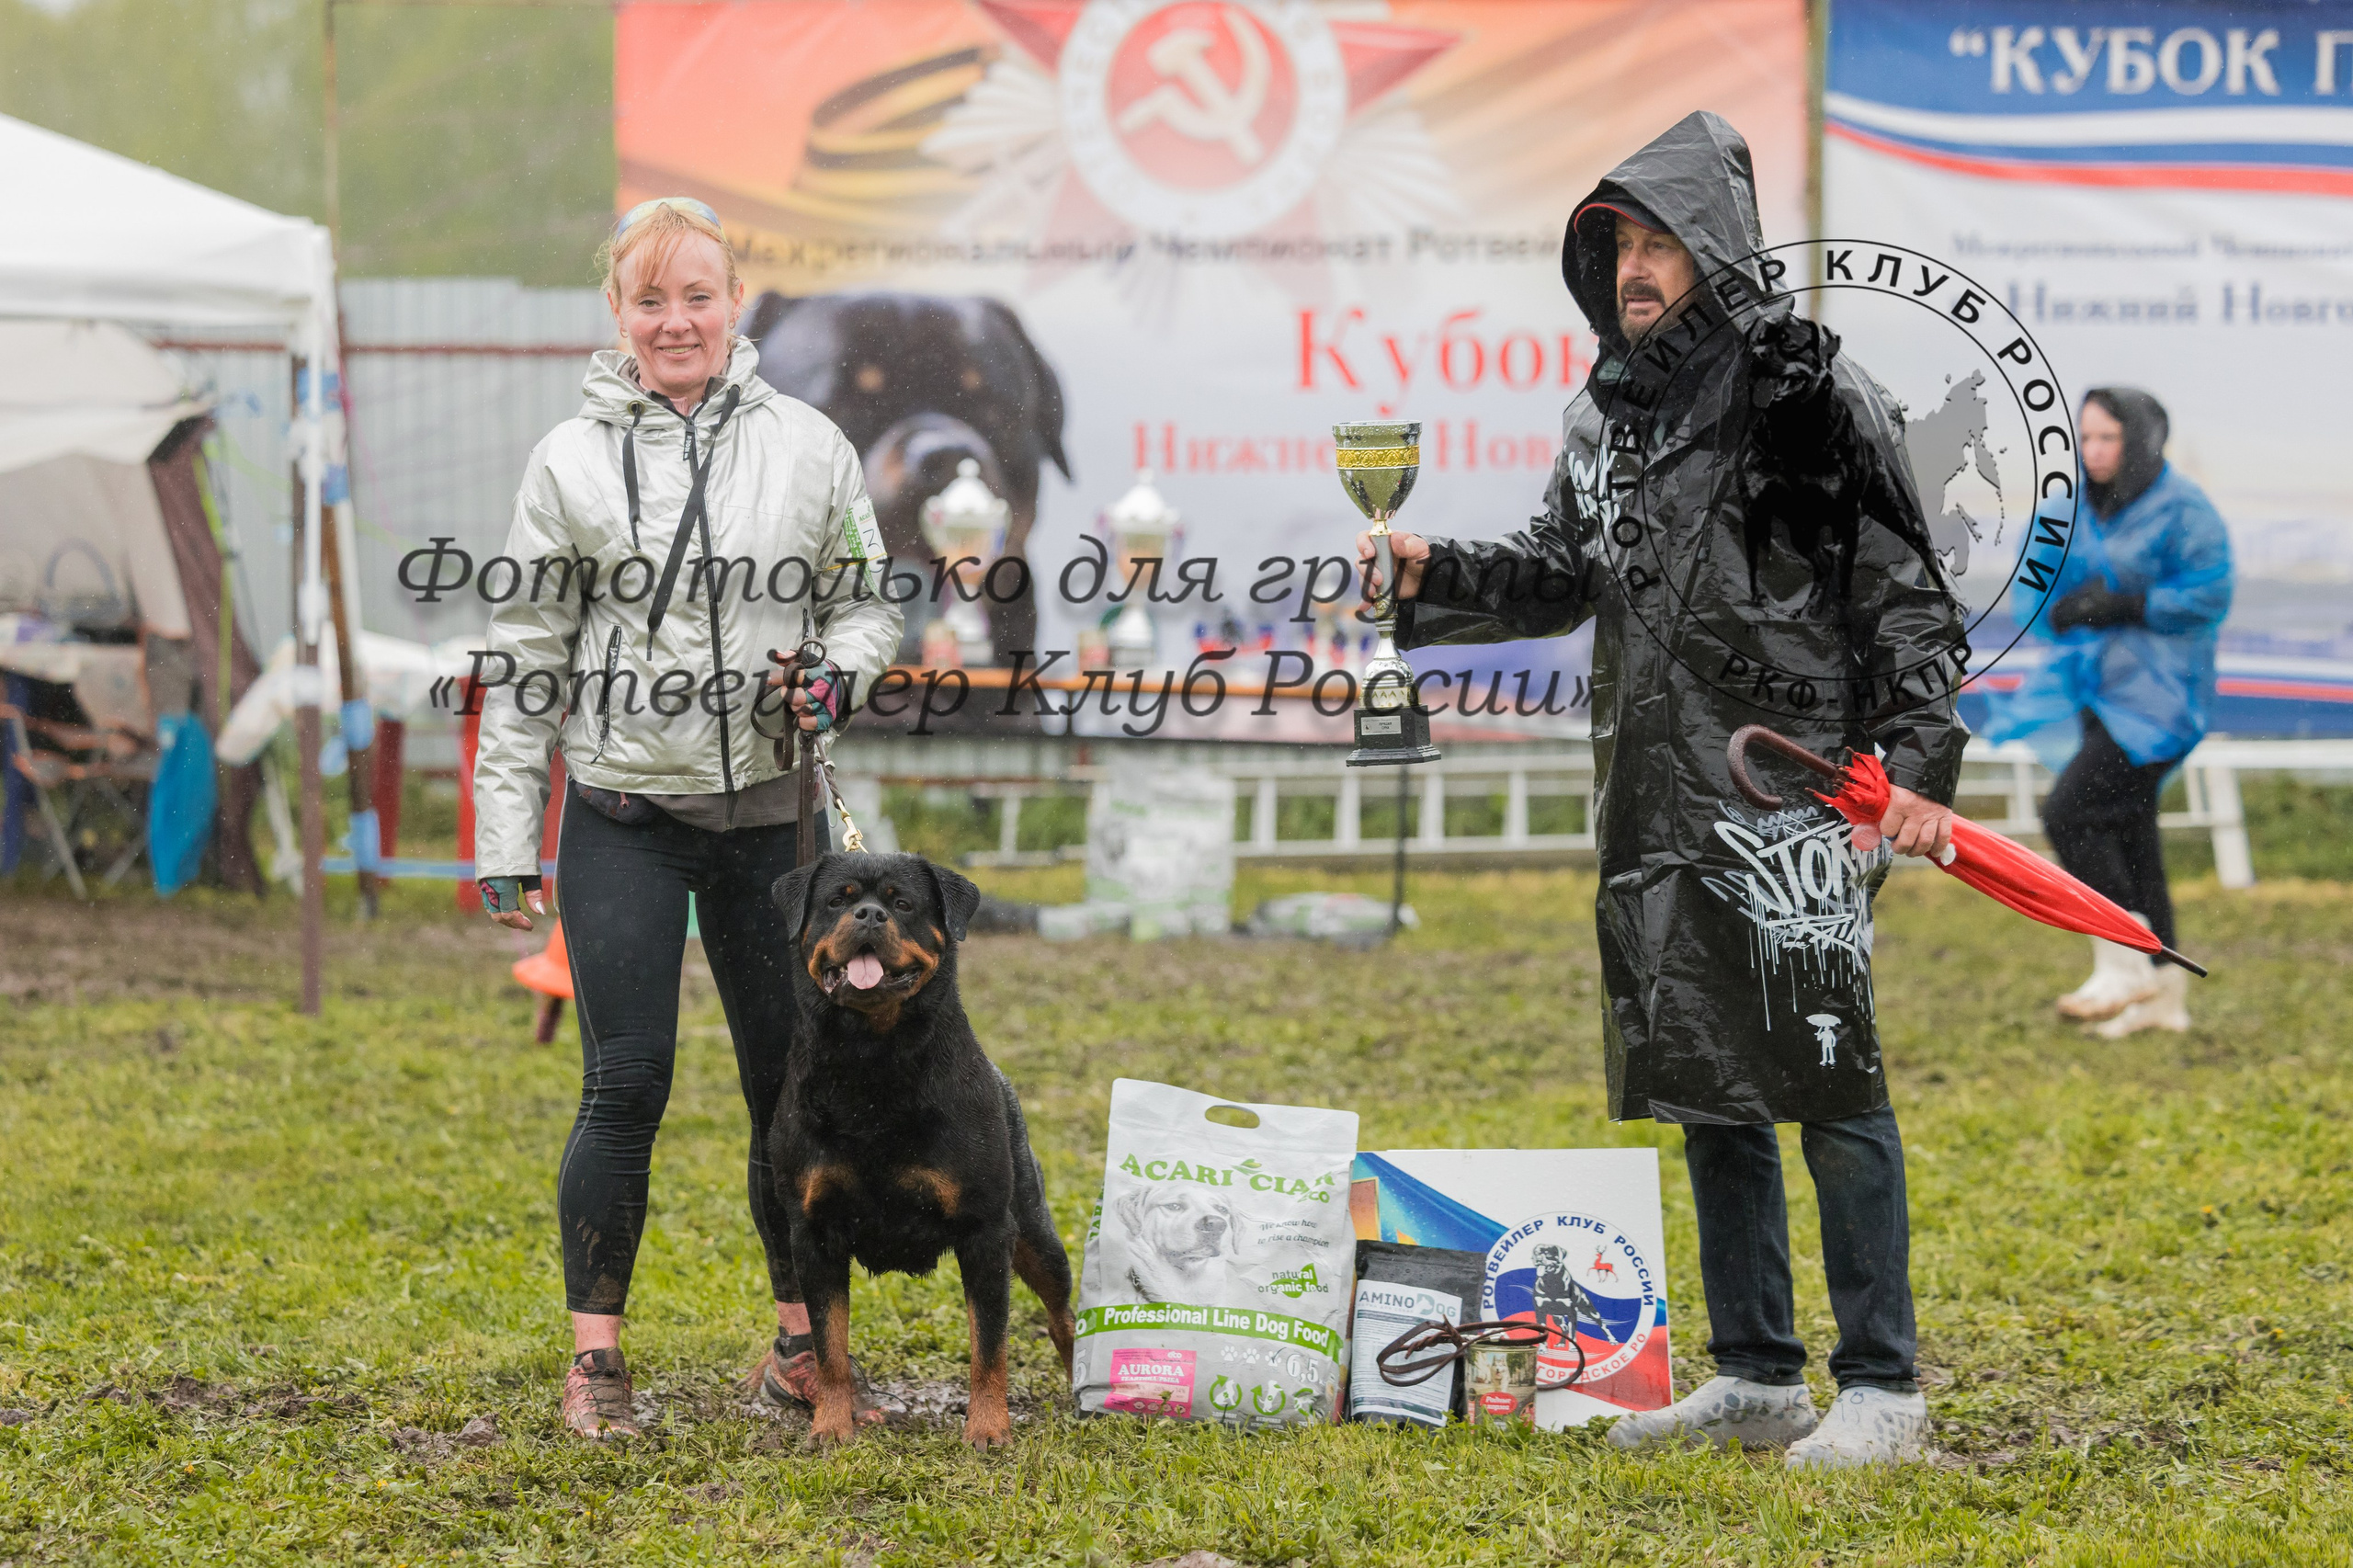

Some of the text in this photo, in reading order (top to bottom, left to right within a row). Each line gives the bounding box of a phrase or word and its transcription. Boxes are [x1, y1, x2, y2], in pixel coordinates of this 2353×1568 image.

[1119, 1153, 1233, 1187] ACARI
[1293, 1233, 1330, 1248] champion
[1483, 1215, 1654, 1310] РОТВЕЙЛЕР КЛУБ РОССИИ
[1272, 1269, 1313, 1279] natural
[1257, 1281, 1329, 1294] organic food
[1104, 1304, 1330, 1347] Professional Line Dog Food
[1630, 1333, 1646, 1352] РО
[1118, 1363, 1185, 1377] AURORA
